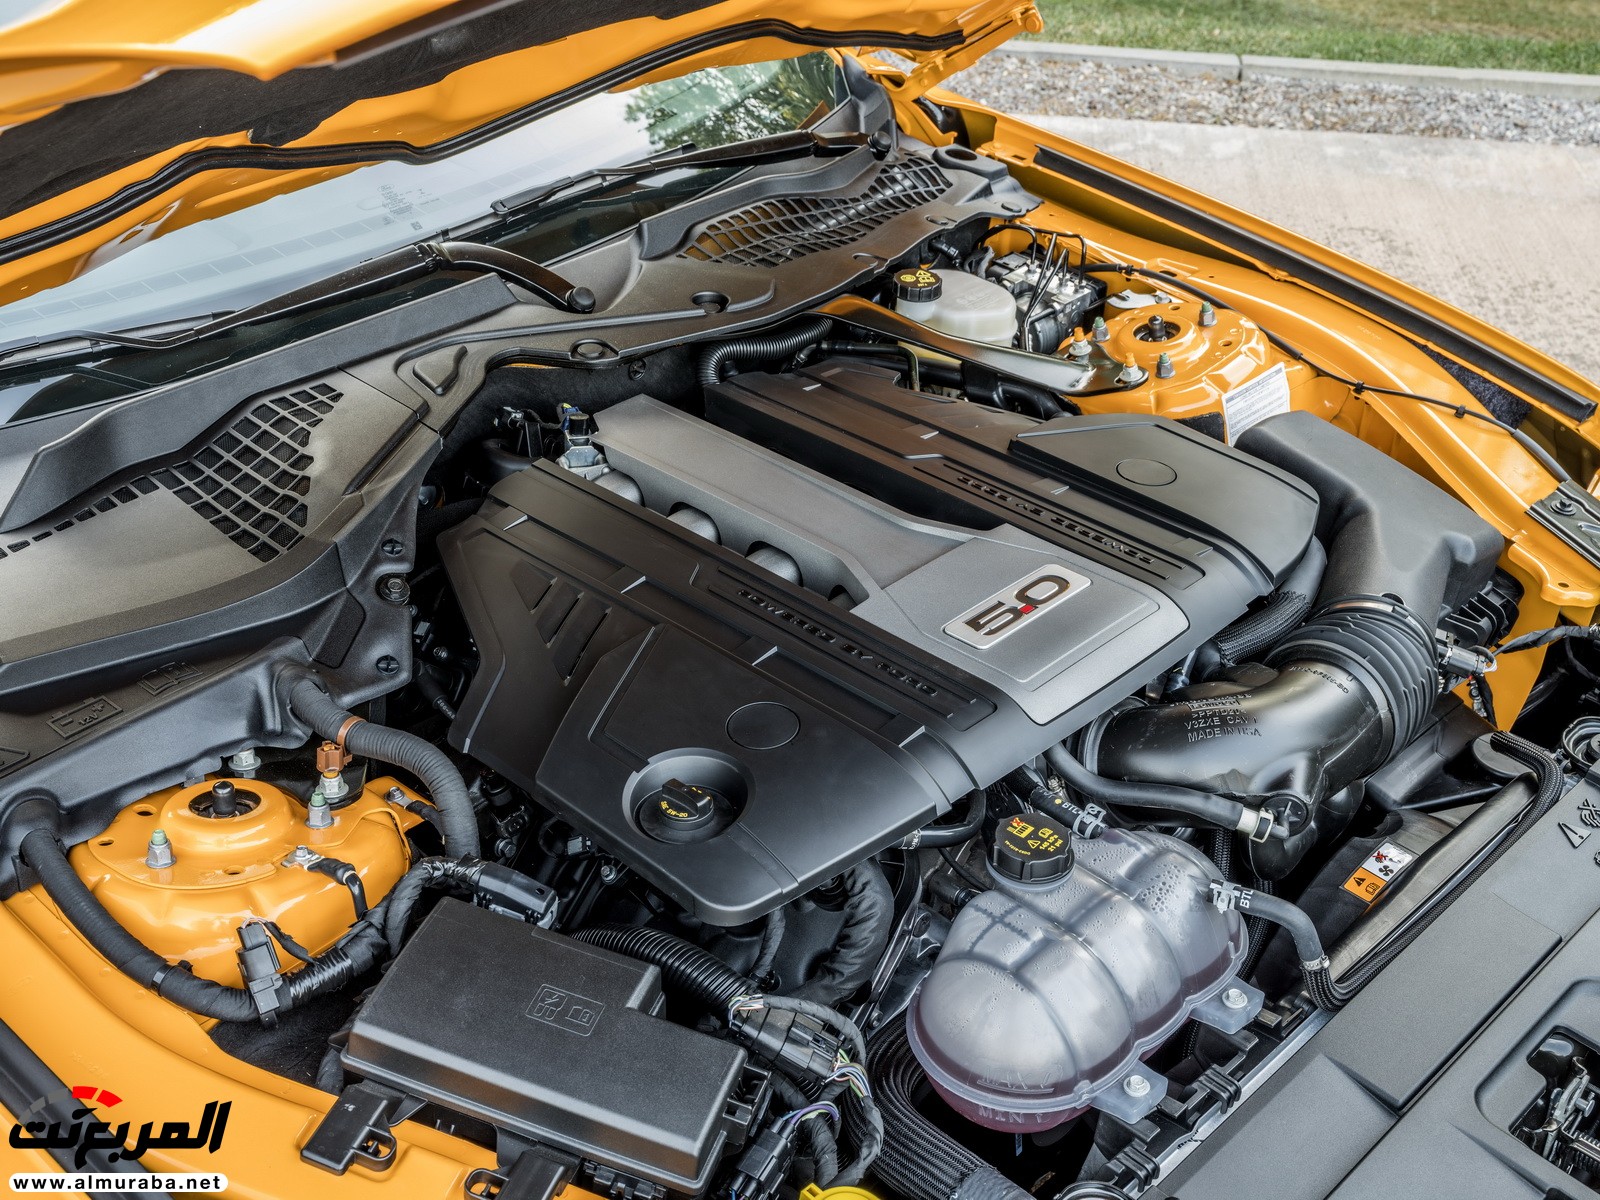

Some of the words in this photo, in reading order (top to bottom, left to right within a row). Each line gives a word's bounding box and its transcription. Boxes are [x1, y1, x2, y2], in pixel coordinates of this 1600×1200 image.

[963, 574, 1071, 636] 5.0
[78, 712, 98, 726] 12V
[1187, 728, 1222, 742] MADE
[1223, 726, 1235, 736] IN
[1239, 890, 1255, 909] BTL
[978, 1104, 1025, 1124] MIN
